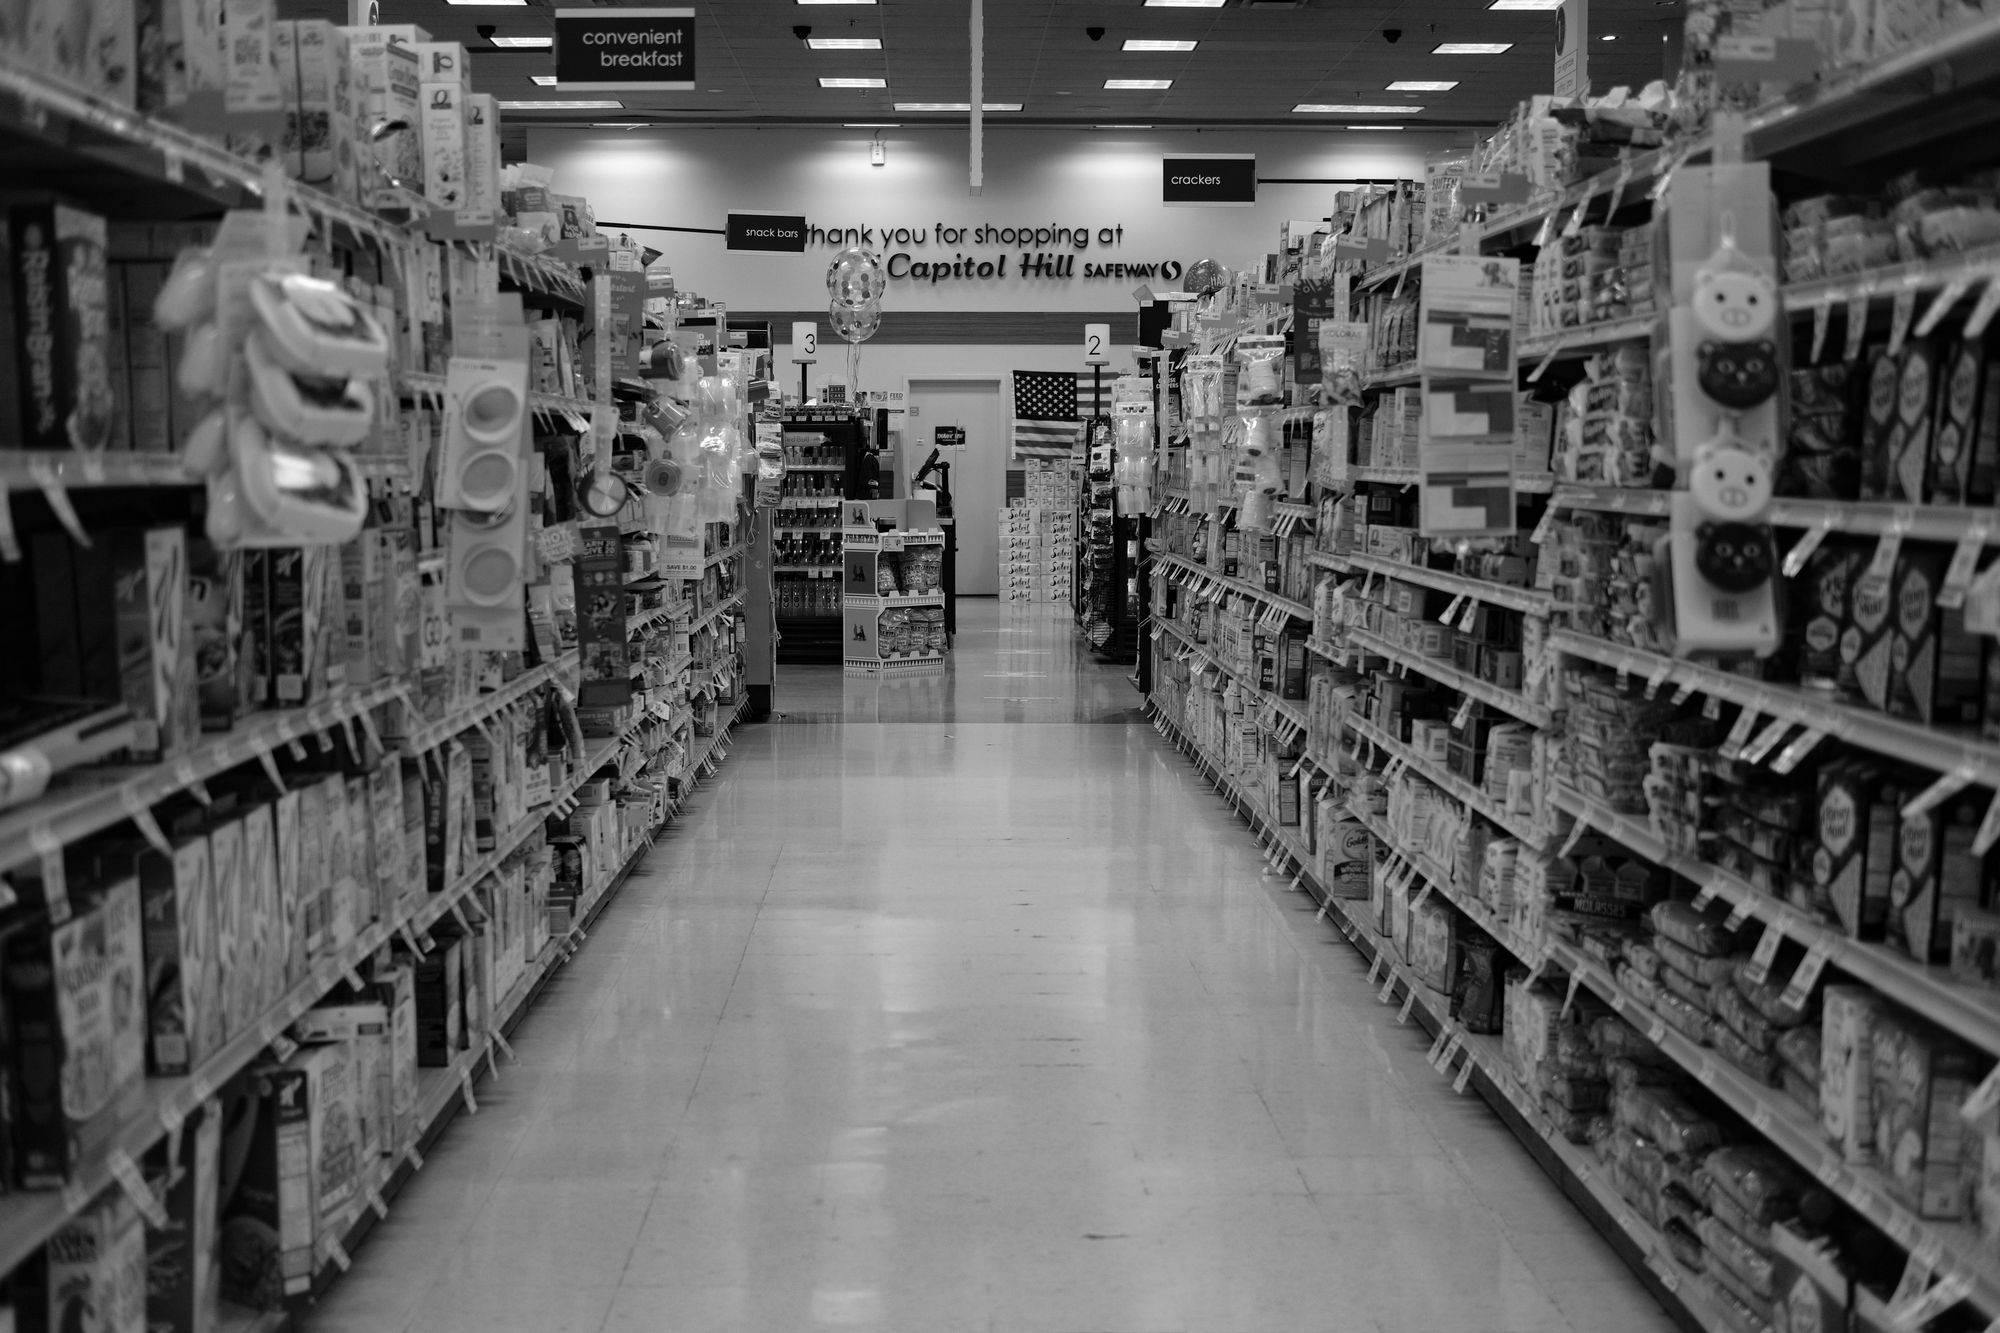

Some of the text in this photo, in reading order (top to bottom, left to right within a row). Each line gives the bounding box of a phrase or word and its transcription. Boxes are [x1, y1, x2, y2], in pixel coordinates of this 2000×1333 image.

[582, 28, 683, 45] convenient
[600, 50, 683, 66] breakfast
[1170, 173, 1221, 186] crackers
[745, 227, 799, 239] snack bars
[804, 222, 1124, 249] thank you for shopping at
[886, 252, 1159, 283] Capitol Hill SAFEWAY
[804, 333, 816, 354] 3
[1088, 335, 1101, 355] 2
[1008, 509, 1031, 519] Soleil
[1008, 522, 1030, 533] Soleil
[1008, 537, 1031, 548] Soleil
[1008, 551, 1031, 561] Soleil
[1008, 564, 1031, 575] Soleil
[1008, 577, 1031, 588] Soleil
[1008, 590, 1031, 600] Soleil
